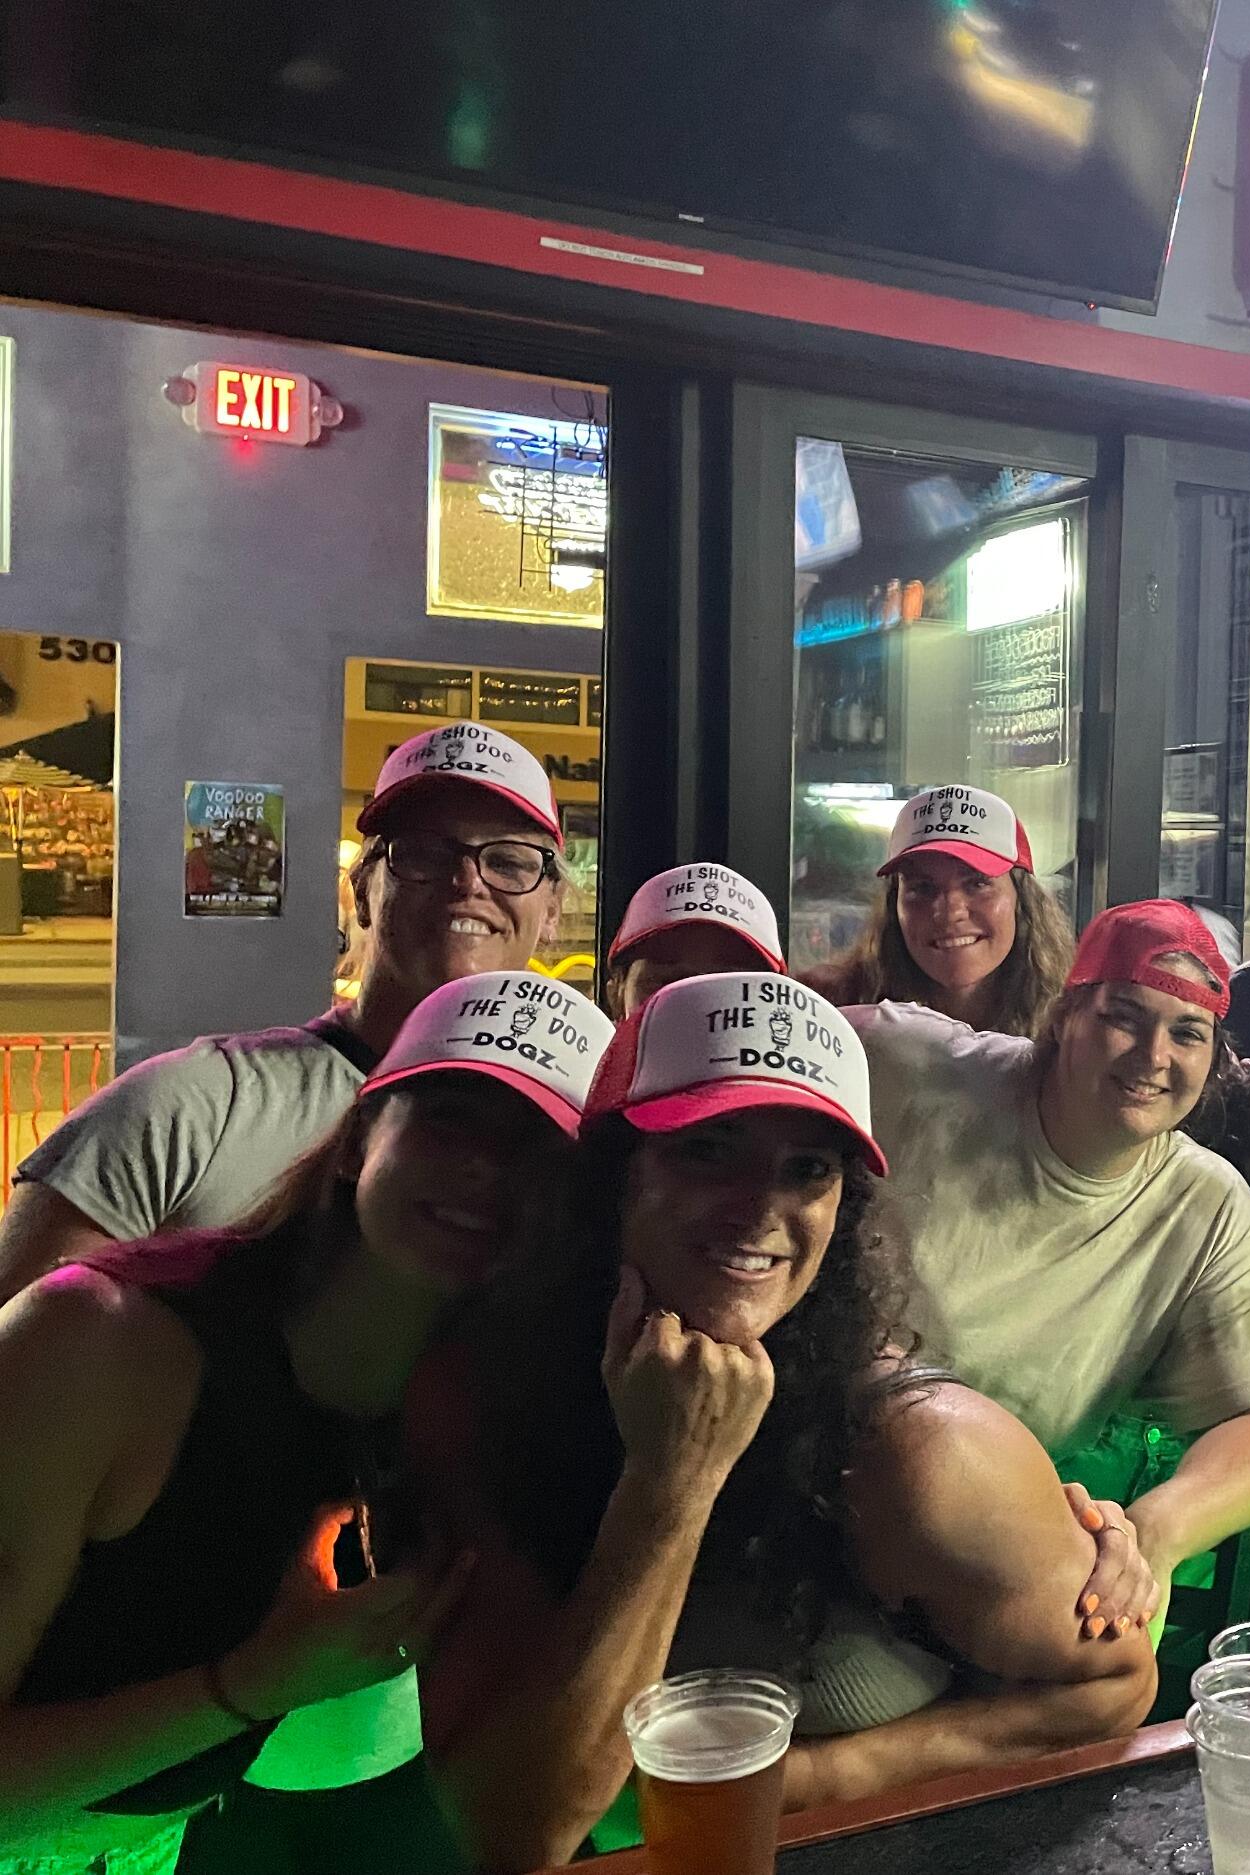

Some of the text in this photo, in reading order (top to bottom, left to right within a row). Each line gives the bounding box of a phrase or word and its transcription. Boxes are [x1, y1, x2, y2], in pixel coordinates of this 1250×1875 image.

[216, 369, 297, 433] EXIT
[39, 636, 116, 664] 530
[441, 725, 493, 742] SHOT
[476, 743, 513, 763] DOG
[205, 787, 265, 804] VOODOO
[937, 787, 972, 801] SHOT
[205, 803, 265, 820] RANGER
[913, 802, 987, 820] THE DOG
[924, 824, 971, 835] DOGZ
[697, 867, 740, 887] SHOT
[666, 881, 756, 911] THE DOG
[684, 902, 740, 921] DOGZ
[498, 979, 577, 1017] I SHOT
[742, 982, 819, 1017] I SHOT
[458, 999, 589, 1055] THE DOG
[706, 1007, 843, 1058] THE DOG
[472, 1031, 557, 1070] DOGZ
[739, 1048, 823, 1083] DOGZ
